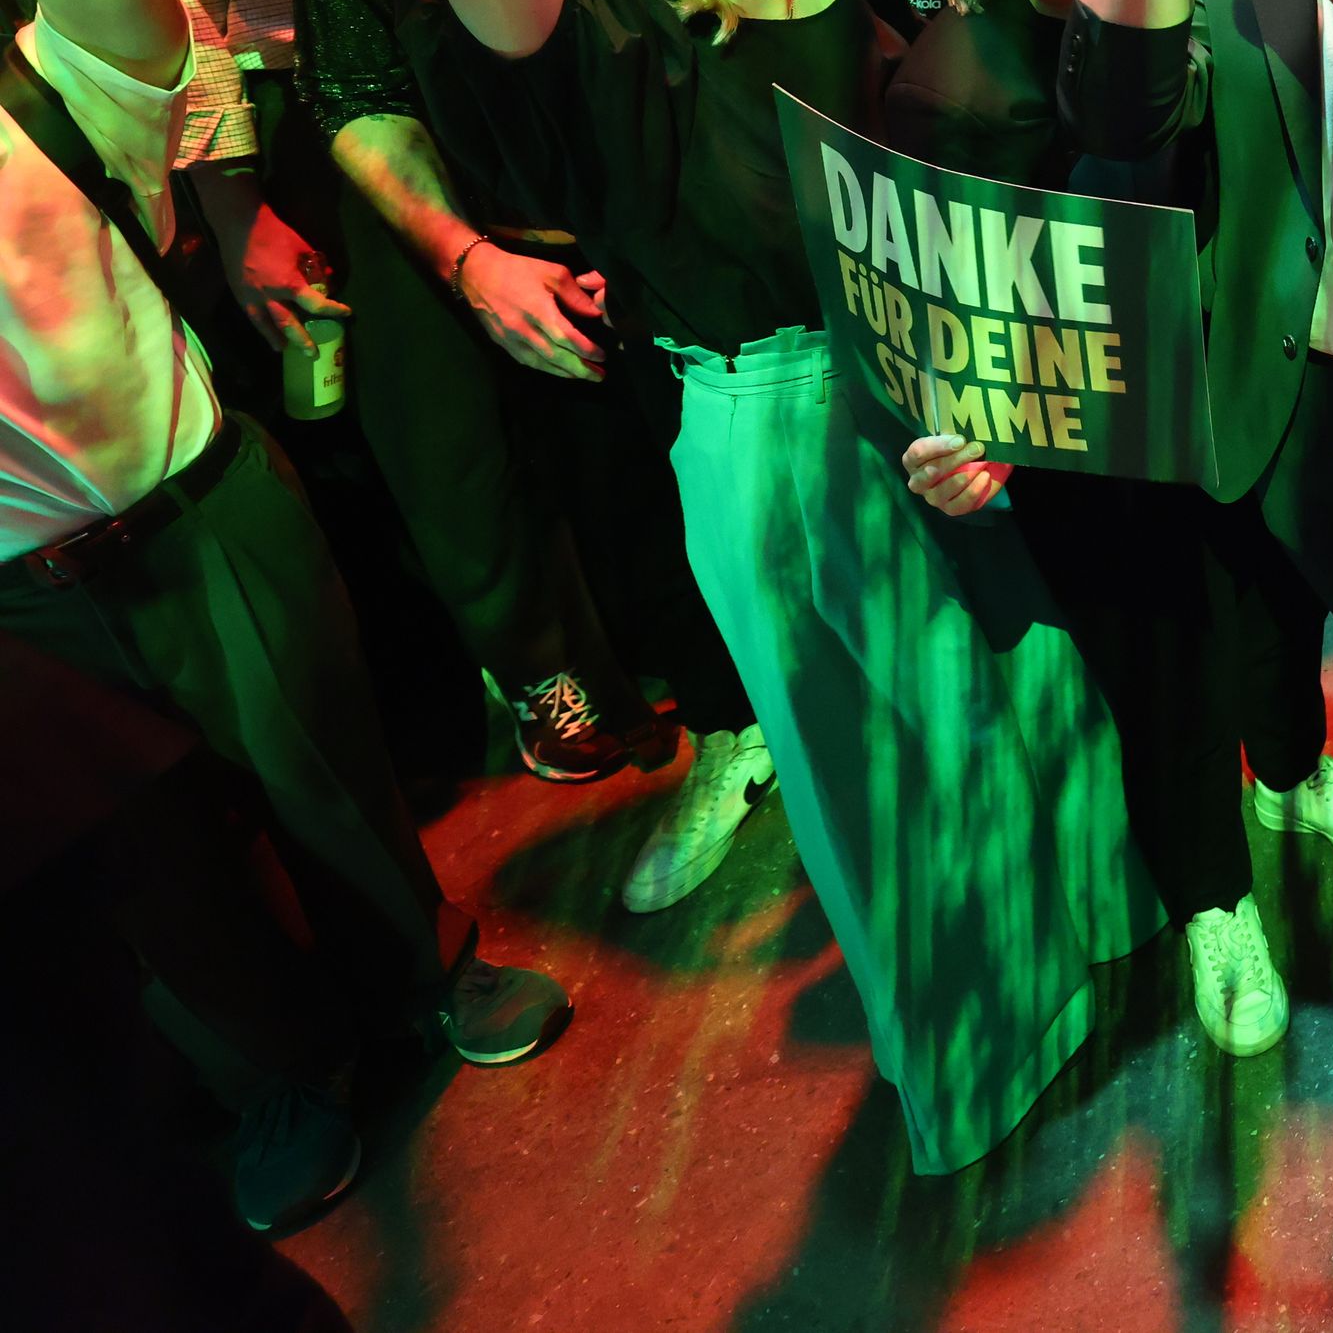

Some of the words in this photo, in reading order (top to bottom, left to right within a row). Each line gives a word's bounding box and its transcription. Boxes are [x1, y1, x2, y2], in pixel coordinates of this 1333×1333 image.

[820, 142, 1113, 325] DANKE
[838, 249, 917, 361] FÜR
[926, 303, 1127, 394] DEINE
[876, 342, 1089, 452] STIMME
